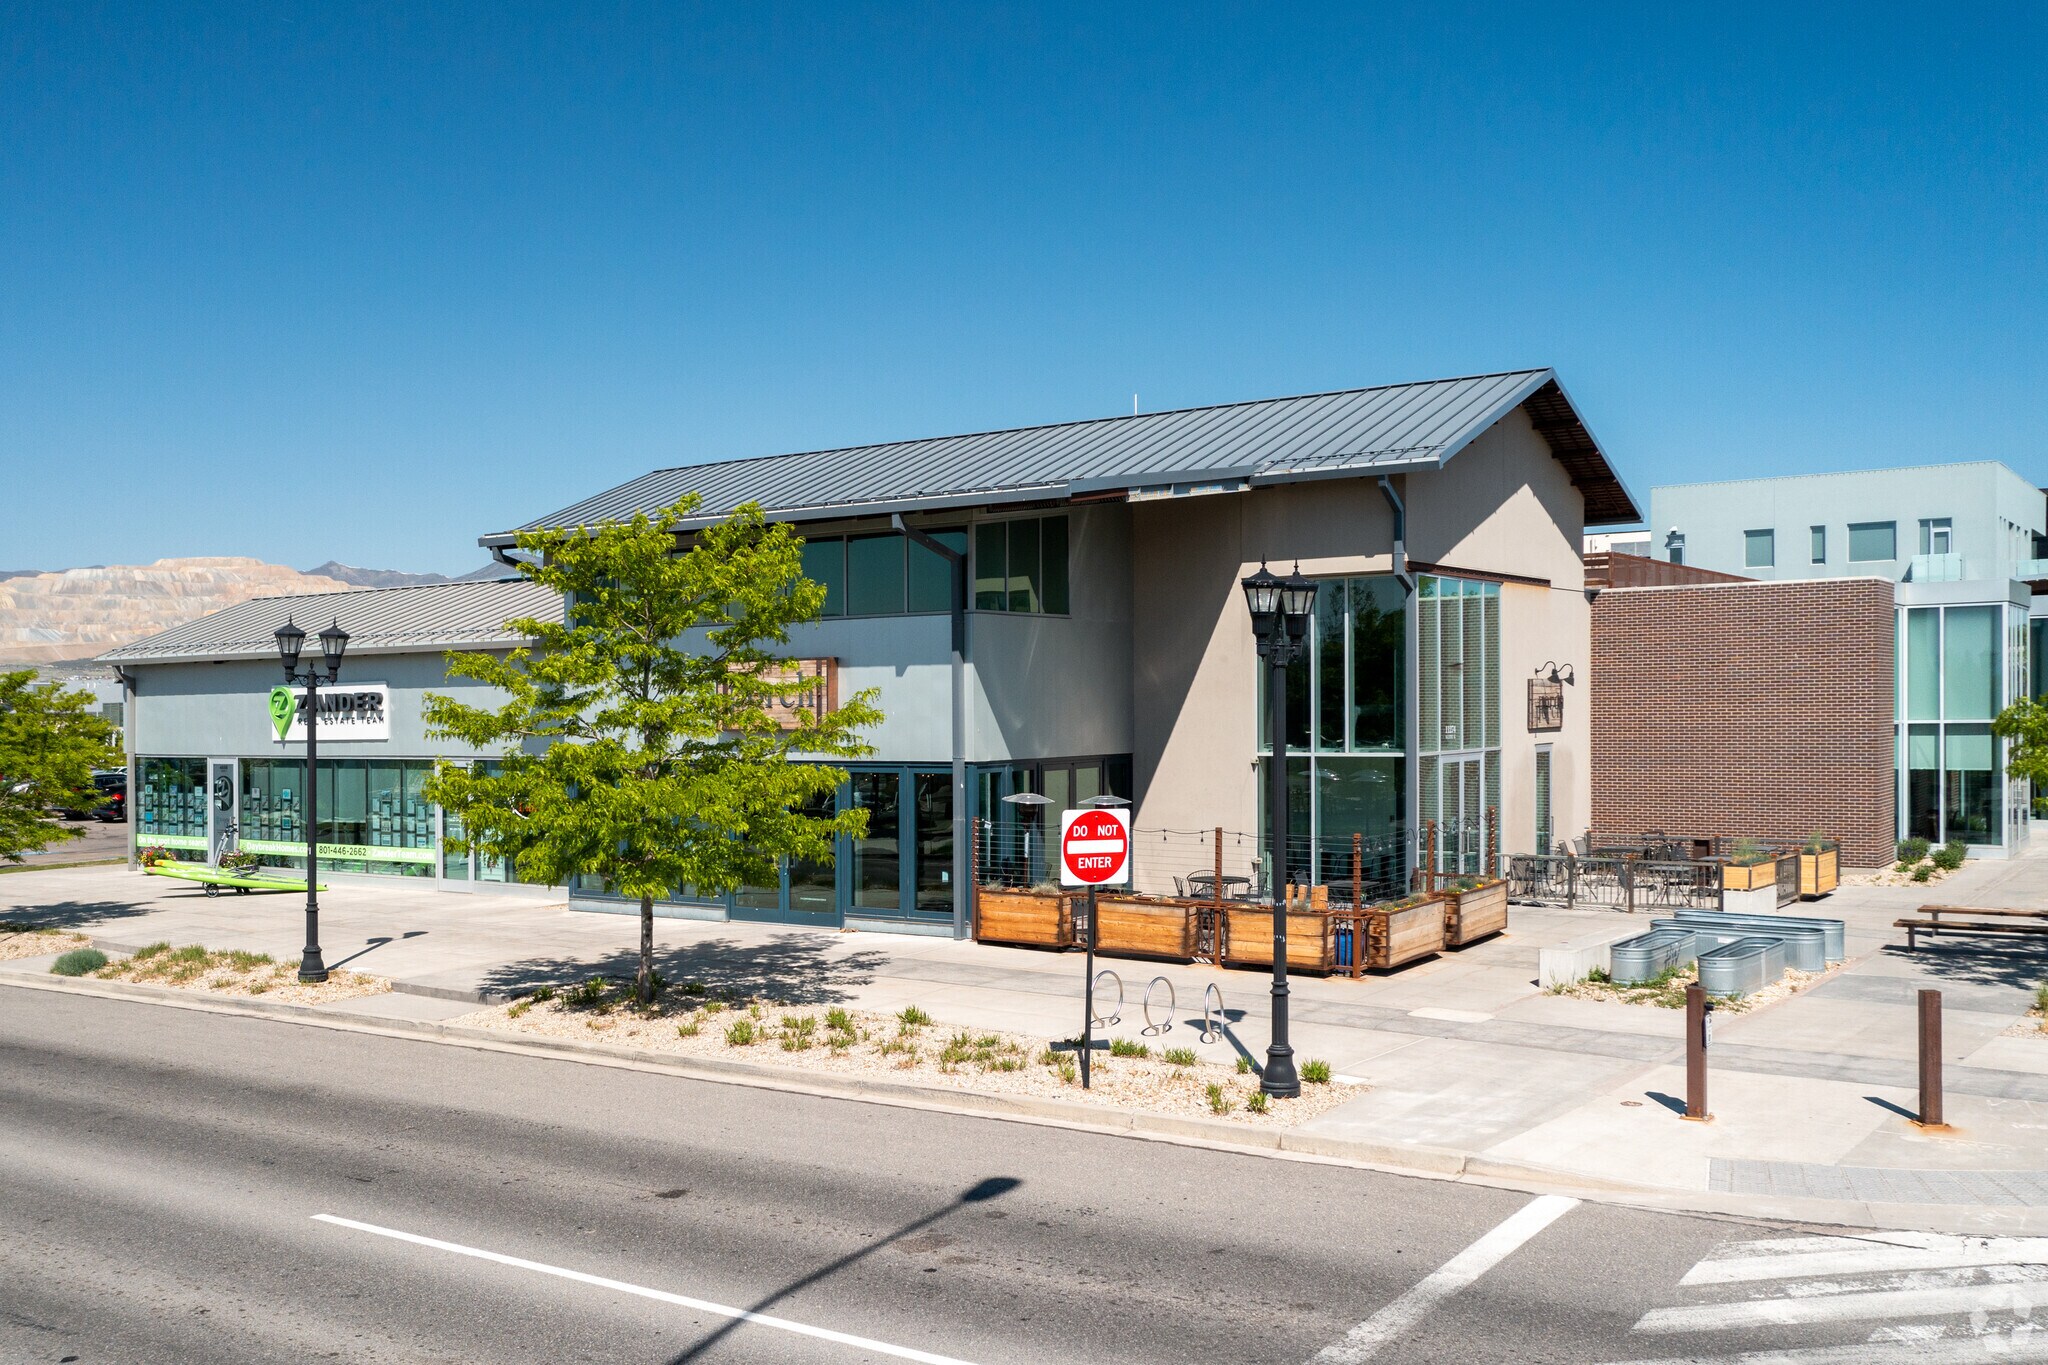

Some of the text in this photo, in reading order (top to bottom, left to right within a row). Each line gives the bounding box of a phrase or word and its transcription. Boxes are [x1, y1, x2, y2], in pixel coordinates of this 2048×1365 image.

[324, 717, 356, 726] ESTATE
[361, 716, 385, 725] TEAM
[1073, 824, 1118, 837] DO NOT
[138, 835, 208, 847] On the spot home search
[246, 842, 434, 860] DaybreakHomes.co 801-446-2662 ZanderTeam.com
[1078, 856, 1112, 869] ENTER
